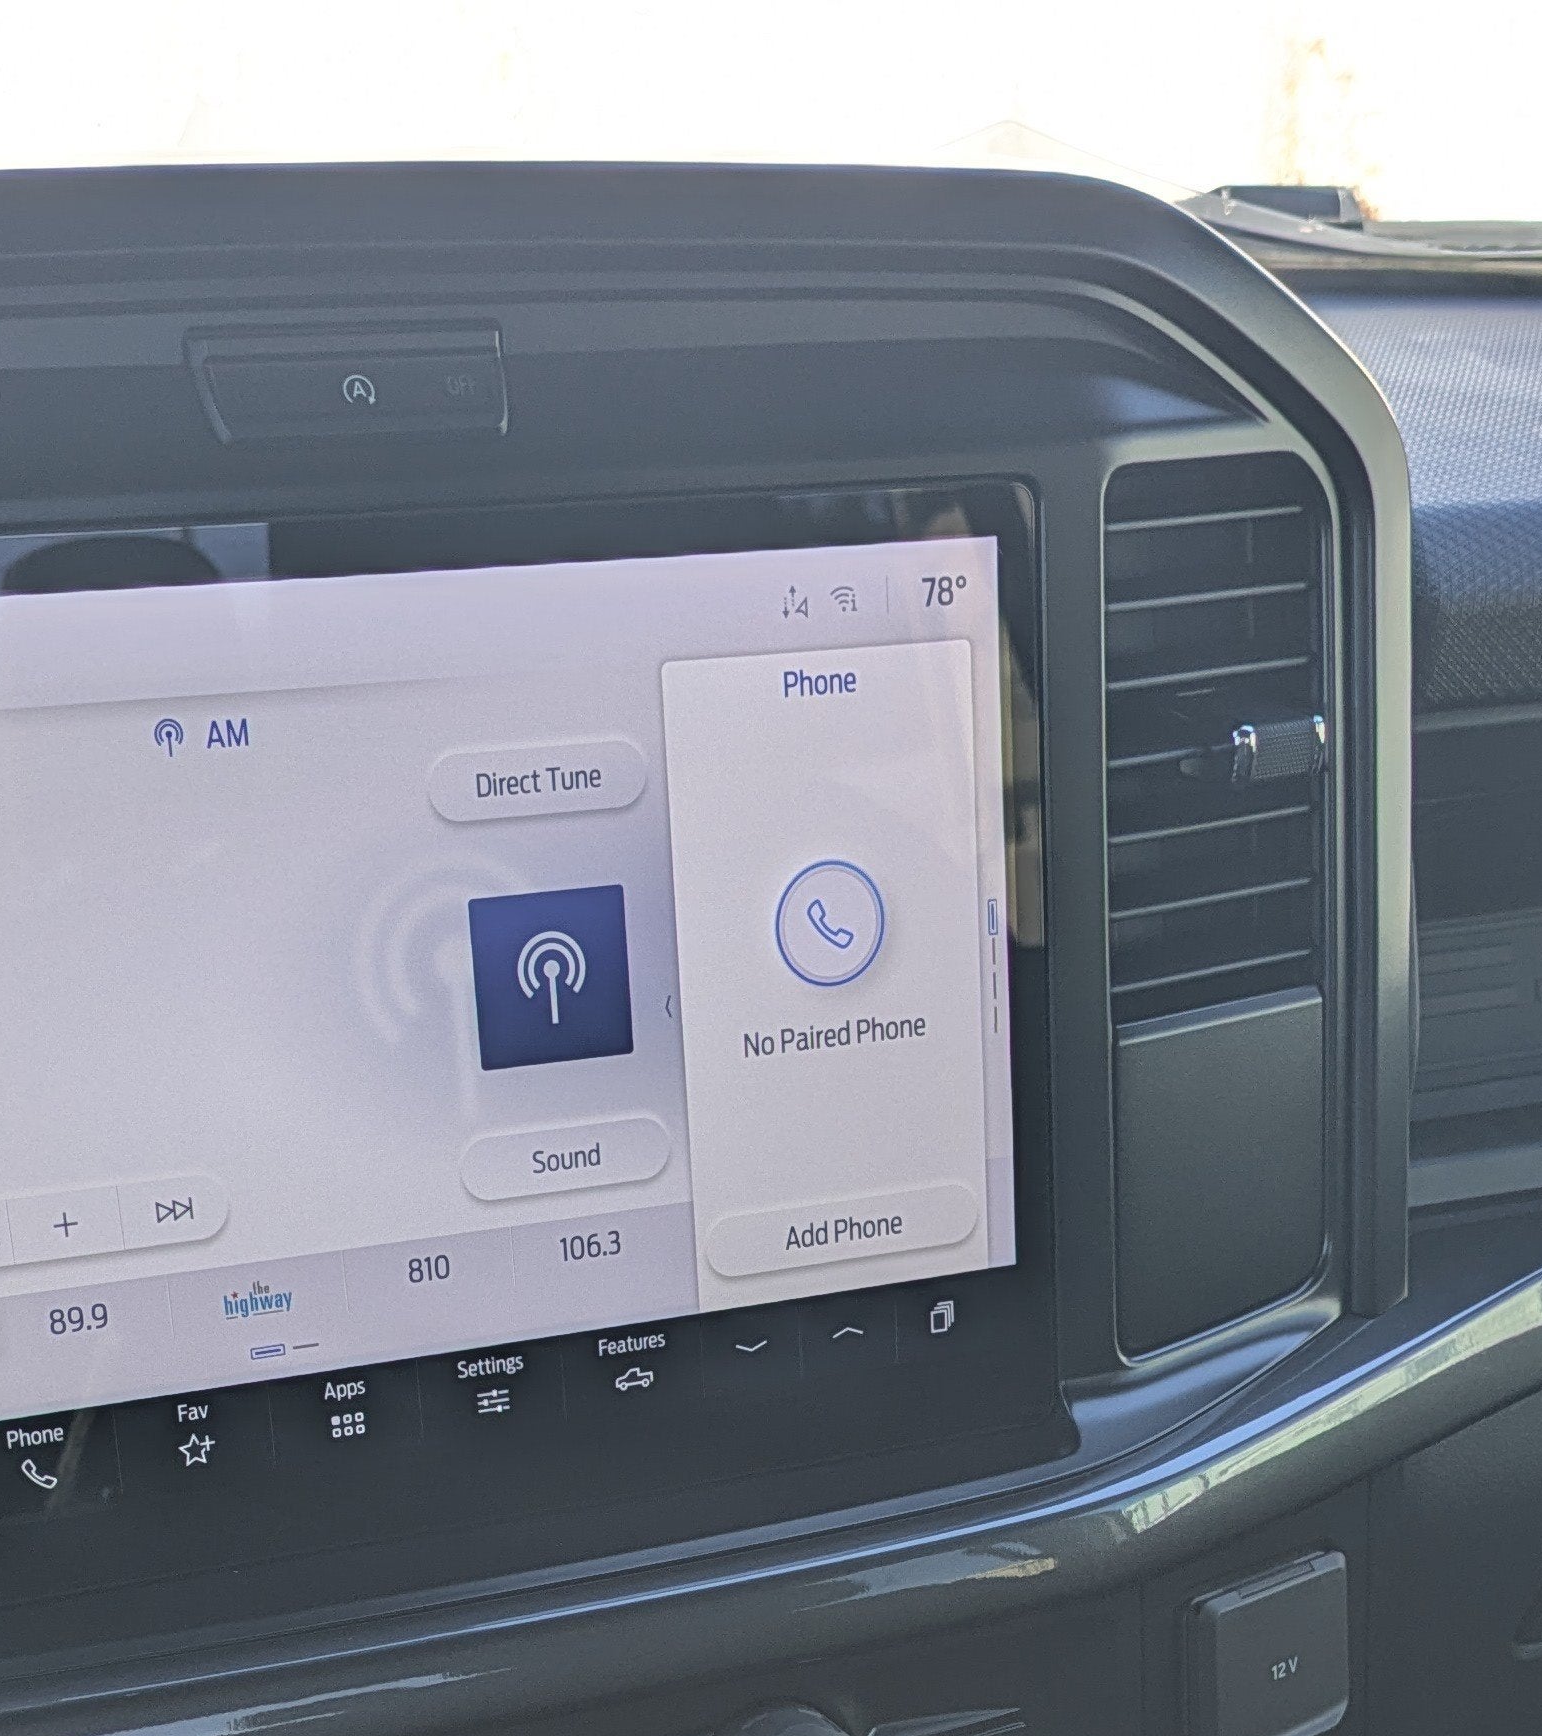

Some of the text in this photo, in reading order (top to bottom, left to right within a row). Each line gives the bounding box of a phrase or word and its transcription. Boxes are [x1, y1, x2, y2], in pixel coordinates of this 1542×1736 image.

[921, 576, 967, 608] 78°
[783, 669, 857, 698] Phone
[206, 718, 249, 749] AM
[475, 766, 602, 798] Direct Tune
[743, 1016, 926, 1058] No Paired Phone
[532, 1142, 601, 1174] Sound
[559, 1230, 621, 1262] 106.3
[785, 1215, 903, 1251] Add Phone
[408, 1254, 450, 1284] 810
[252, 1280, 270, 1295] the
[49, 1303, 108, 1335] 89.9
[223, 1291, 293, 1318] highway
[598, 1332, 666, 1355] Features
[457, 1353, 524, 1379] Settings
[324, 1379, 366, 1402] Apps
[177, 1403, 209, 1423] Fav
[6, 1423, 64, 1450] Phone
